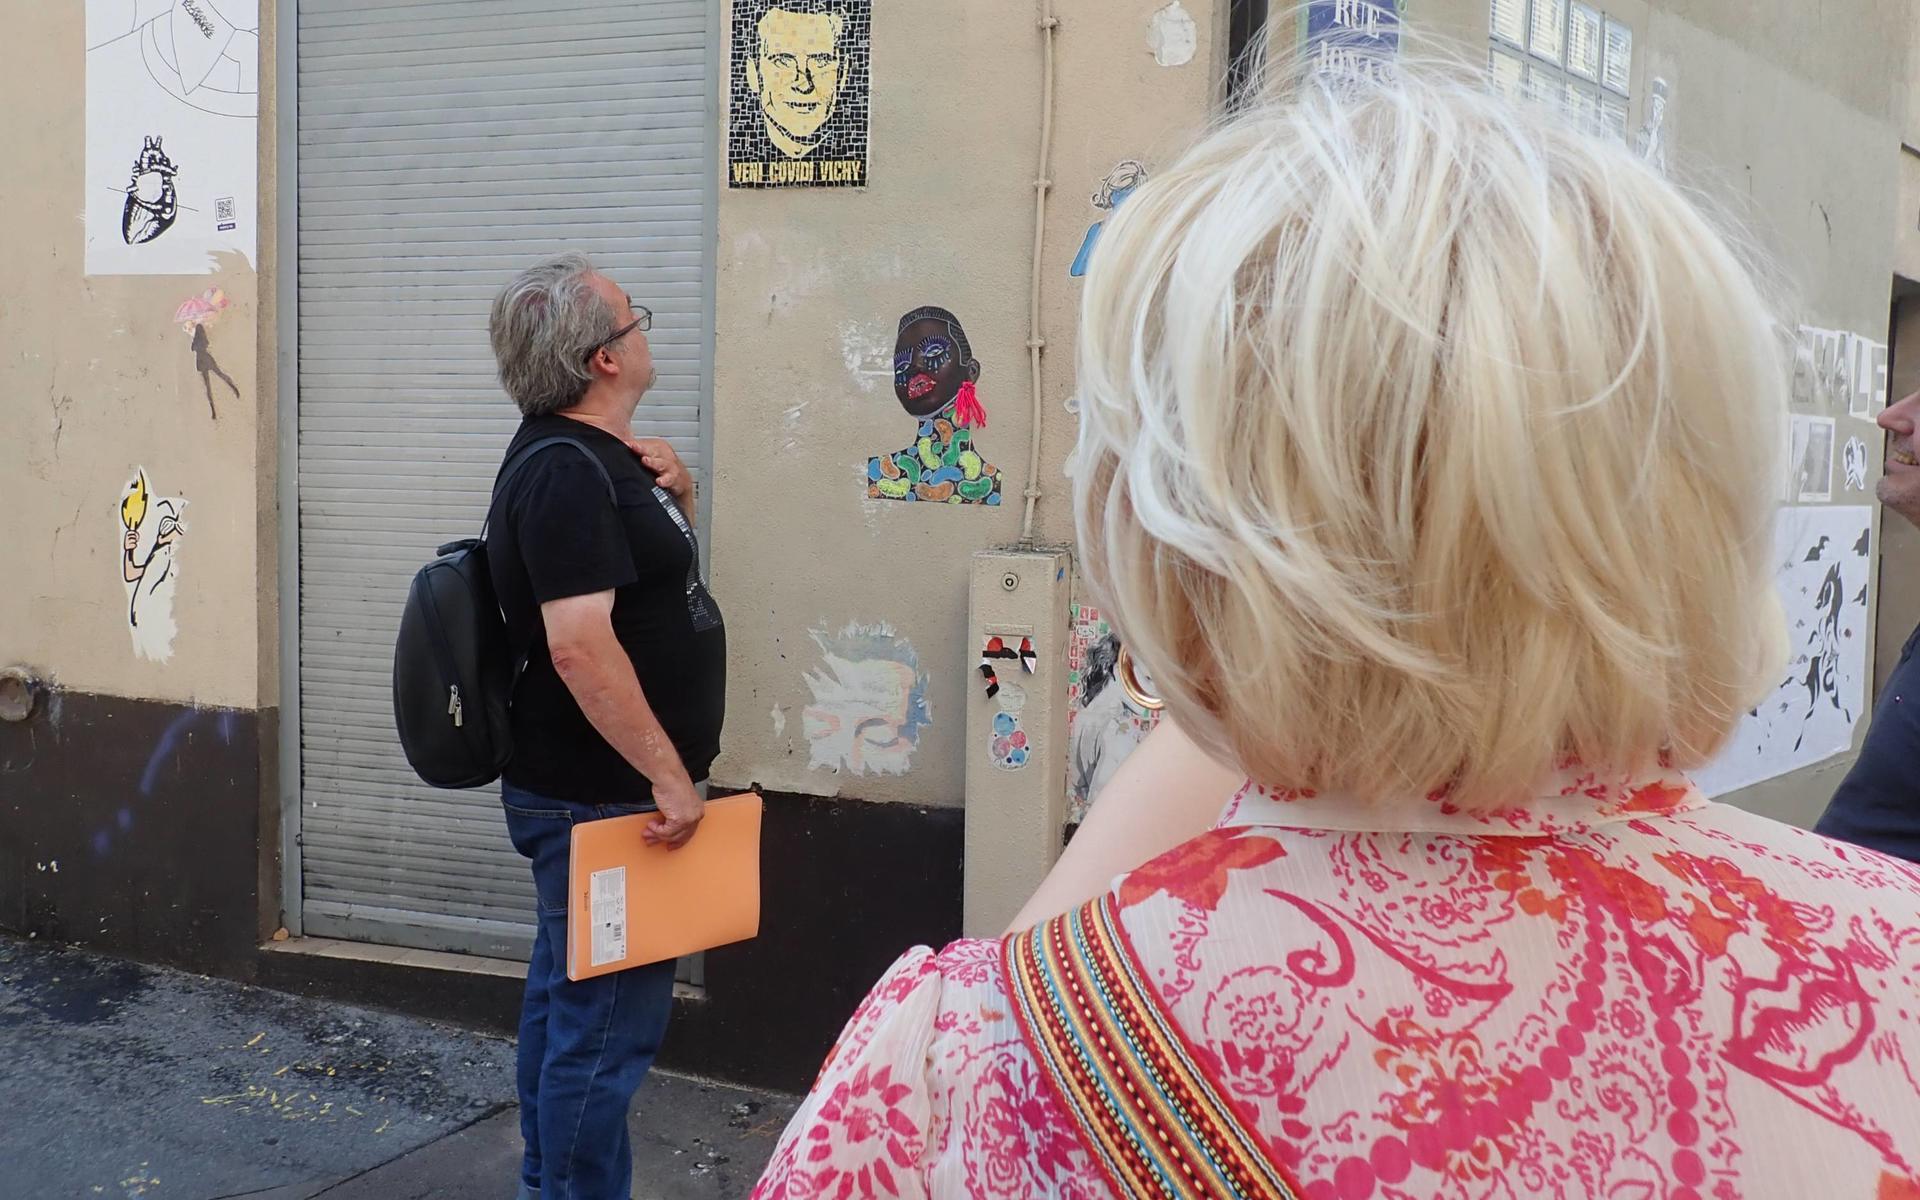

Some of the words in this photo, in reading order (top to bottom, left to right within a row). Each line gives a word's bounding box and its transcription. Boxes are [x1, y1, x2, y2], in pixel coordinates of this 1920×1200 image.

[1335, 0, 1379, 39] RUE
[733, 162, 763, 182] VENI
[769, 161, 814, 182] COVIDI
[820, 161, 861, 181] VICHY
